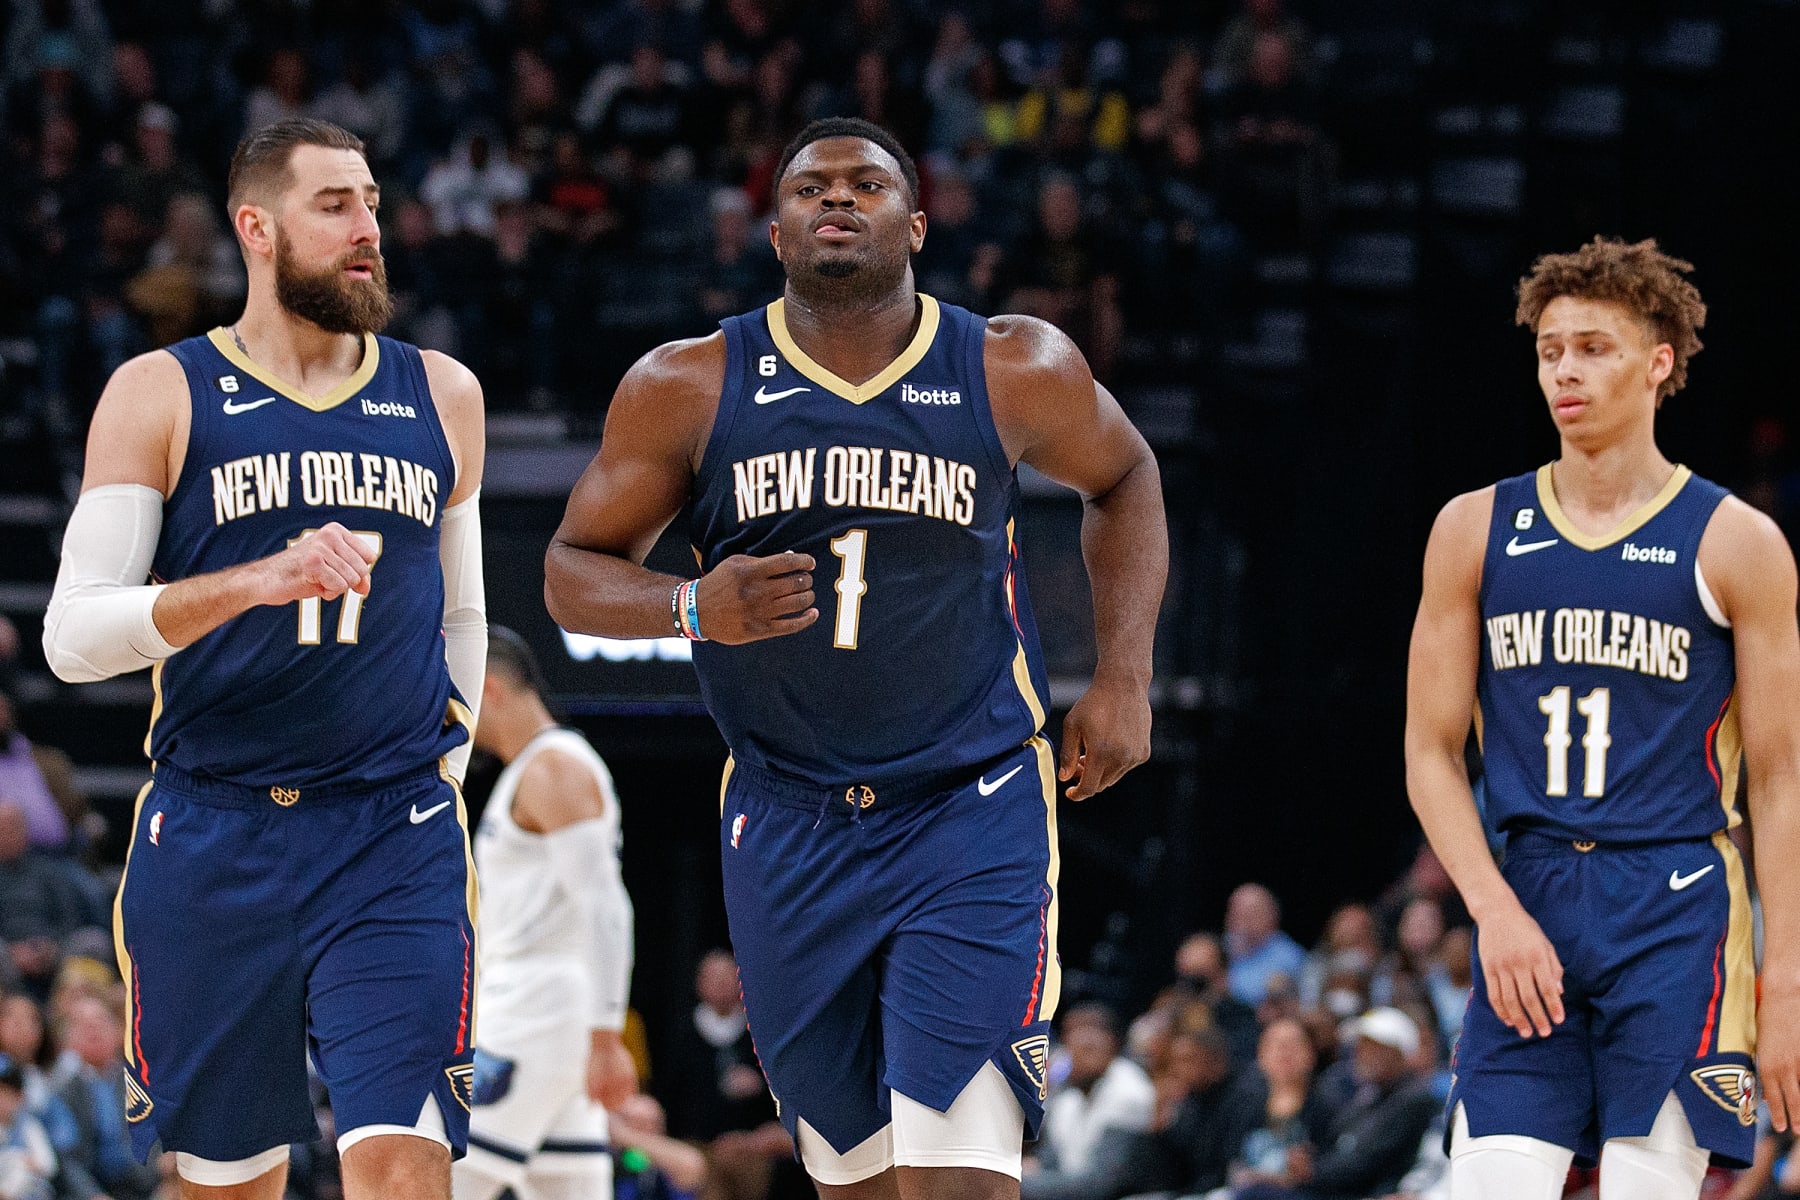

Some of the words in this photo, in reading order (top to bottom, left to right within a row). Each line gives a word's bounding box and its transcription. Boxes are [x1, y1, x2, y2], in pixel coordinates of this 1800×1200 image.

[759, 355, 777, 376] 6
[219, 375, 239, 393] 6
[902, 384, 961, 405] ibotta
[361, 399, 416, 418] ibotta
[211, 452, 291, 526] NEW
[300, 450, 438, 528] ORLEANS
[733, 448, 817, 523] NEW
[824, 446, 977, 526] ORLEANS
[1514, 508, 1535, 530] 6
[1621, 543, 1677, 564] ibotta
[830, 529, 868, 650] 1
[1486, 609, 1547, 671] NEW
[1552, 608, 1691, 682] ORLEANS
[1538, 685, 1612, 798] 11
